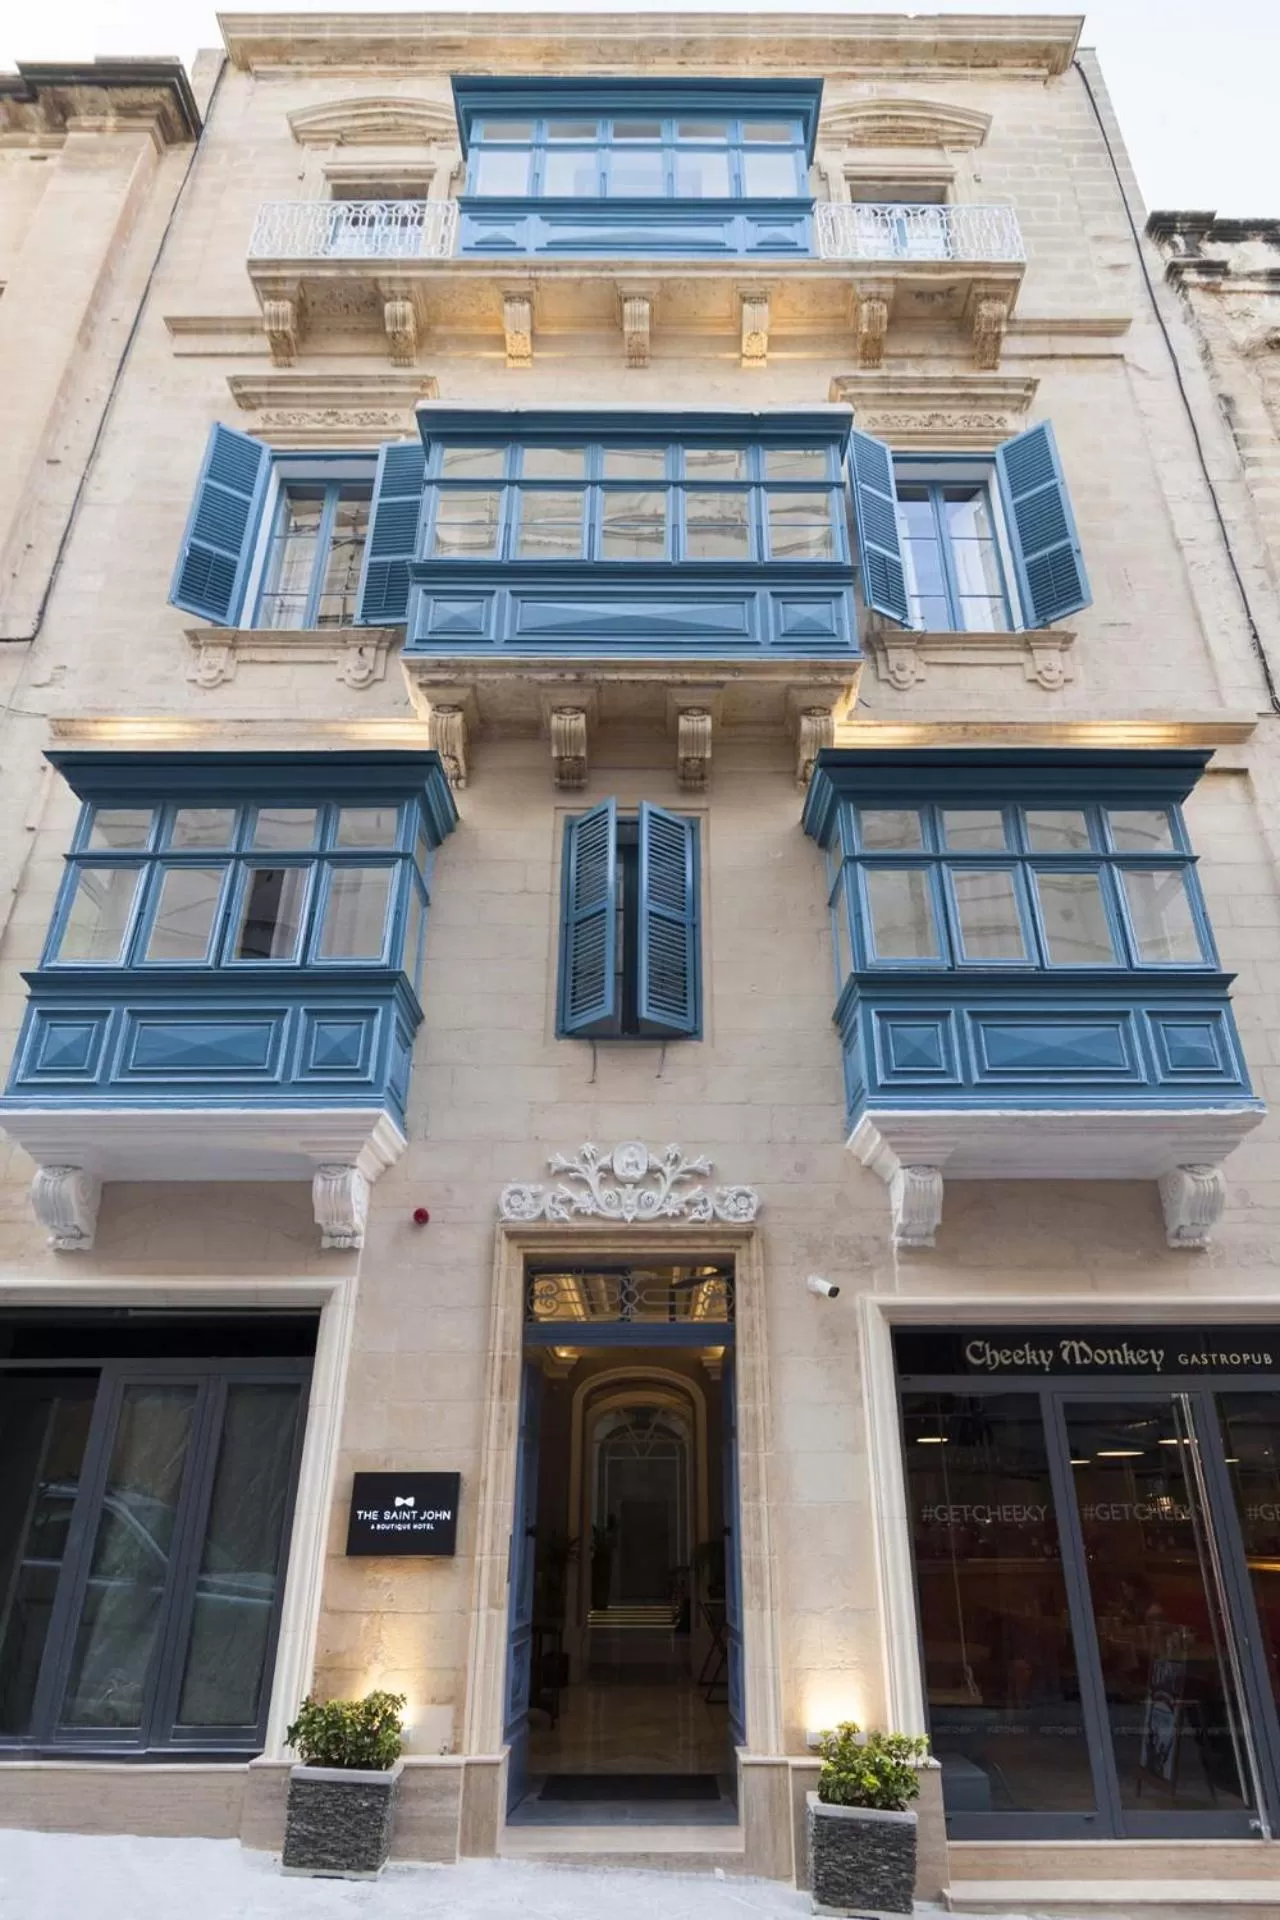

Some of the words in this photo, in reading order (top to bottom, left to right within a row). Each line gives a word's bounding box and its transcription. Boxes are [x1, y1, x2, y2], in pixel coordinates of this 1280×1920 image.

[966, 1340, 1053, 1372] Cheeky
[1060, 1340, 1164, 1372] Monkey
[1178, 1353, 1273, 1365] GASTROPUB
[357, 1510, 379, 1520] THE
[383, 1510, 418, 1520] SAINT
[420, 1510, 451, 1520] JOHN
[921, 1504, 1048, 1522] #GETCHEEKY
[376, 1523, 411, 1531] BOUTIQUE
